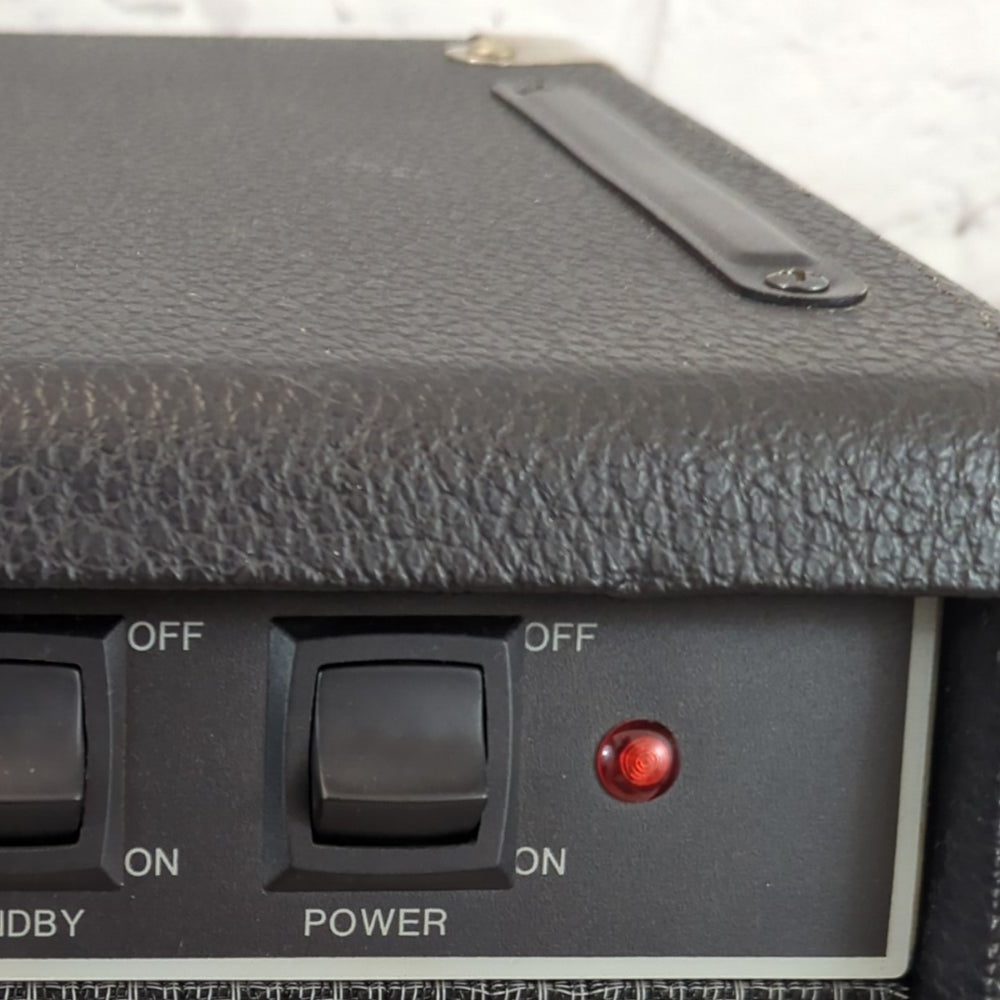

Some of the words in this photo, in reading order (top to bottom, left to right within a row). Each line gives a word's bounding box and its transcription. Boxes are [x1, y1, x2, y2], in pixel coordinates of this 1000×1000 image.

[127, 621, 204, 652] OFF
[524, 621, 598, 653] OFF
[124, 846, 180, 878] ON
[515, 846, 567, 877] ON
[303, 907, 448, 938] POWER
